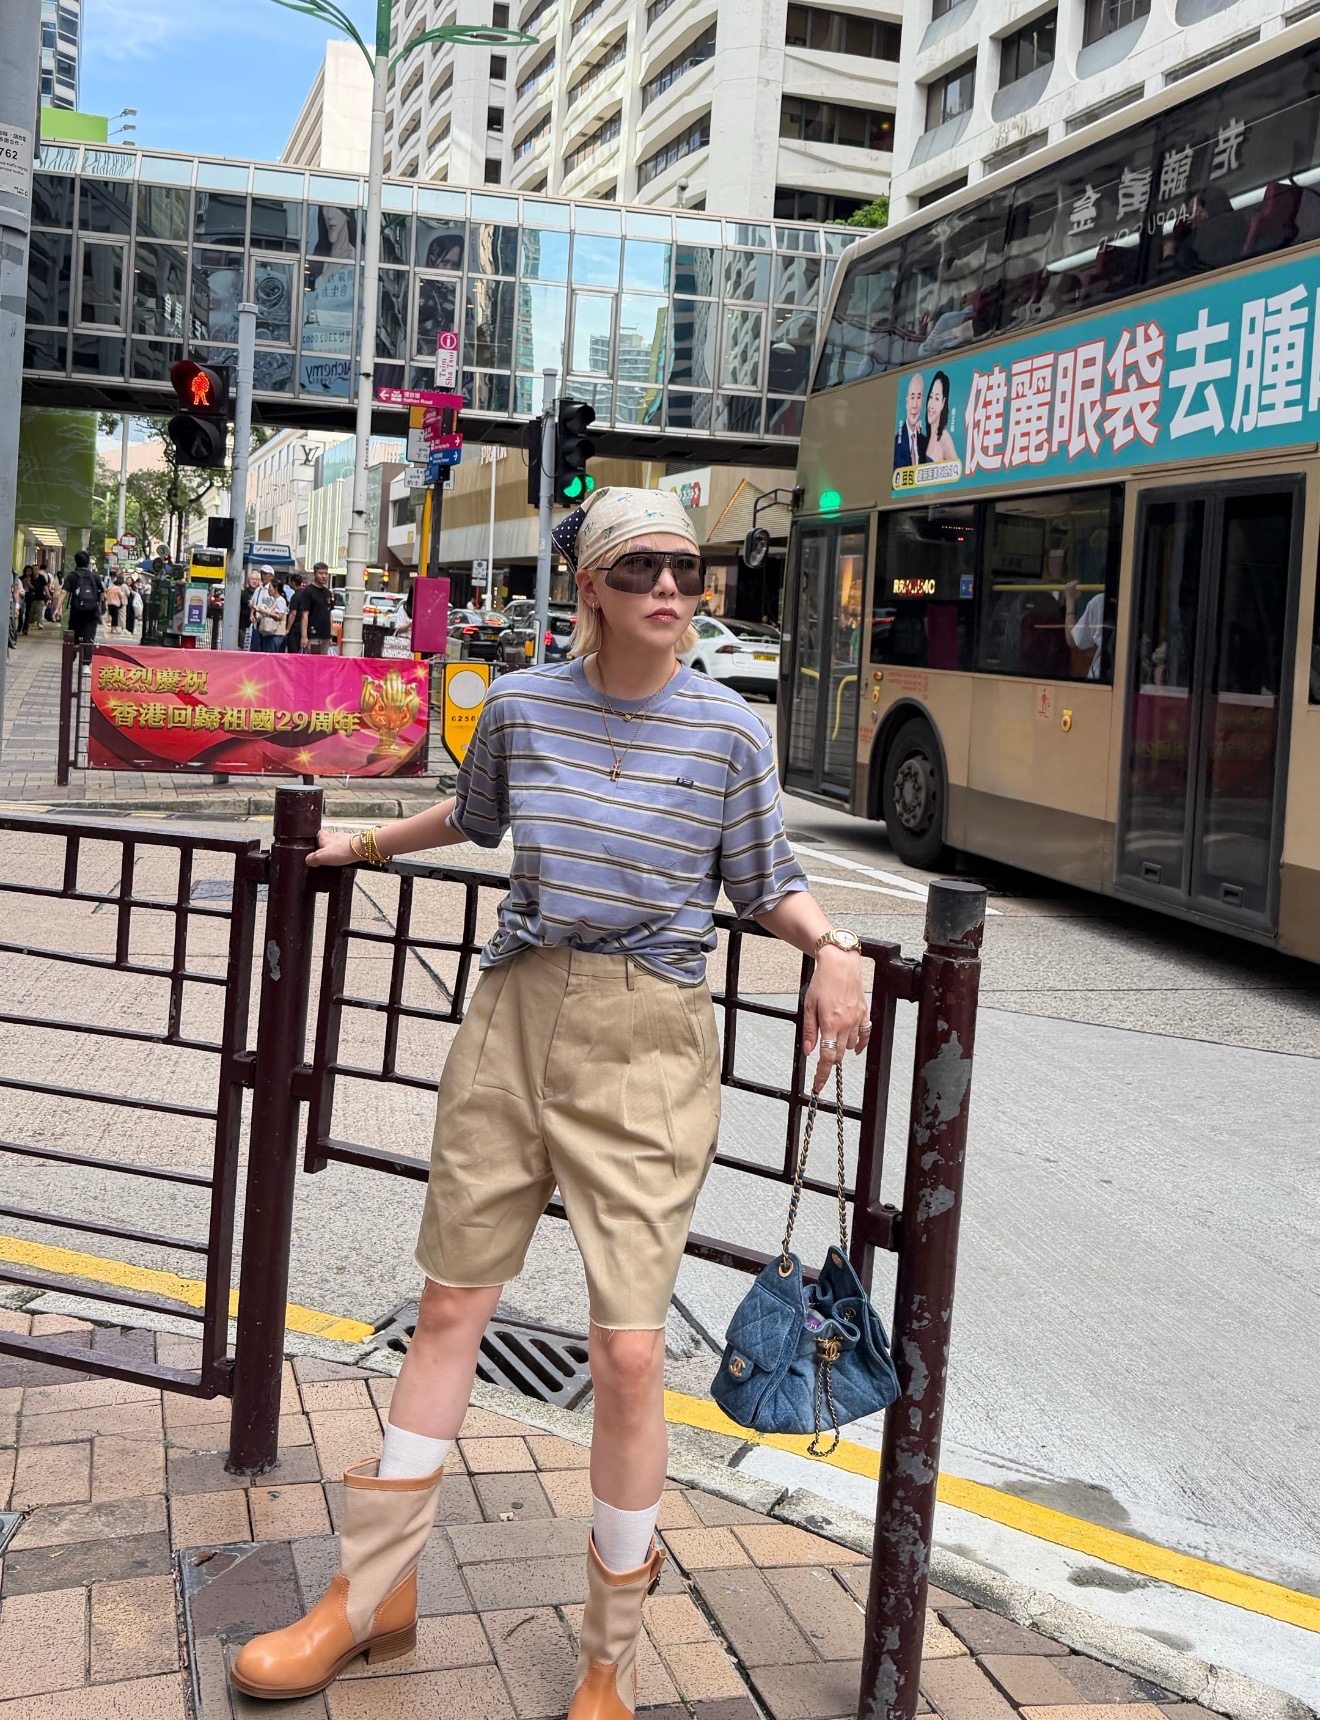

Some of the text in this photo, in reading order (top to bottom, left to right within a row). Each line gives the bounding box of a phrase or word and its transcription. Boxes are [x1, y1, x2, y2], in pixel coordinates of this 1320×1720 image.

[439, 358, 447, 377] Tsim
[964, 283, 1320, 475] 健麗眼袋去腫
[98, 664, 209, 695] 熱烈慶祝
[111, 702, 362, 736] 香港回歸祖國29周年
